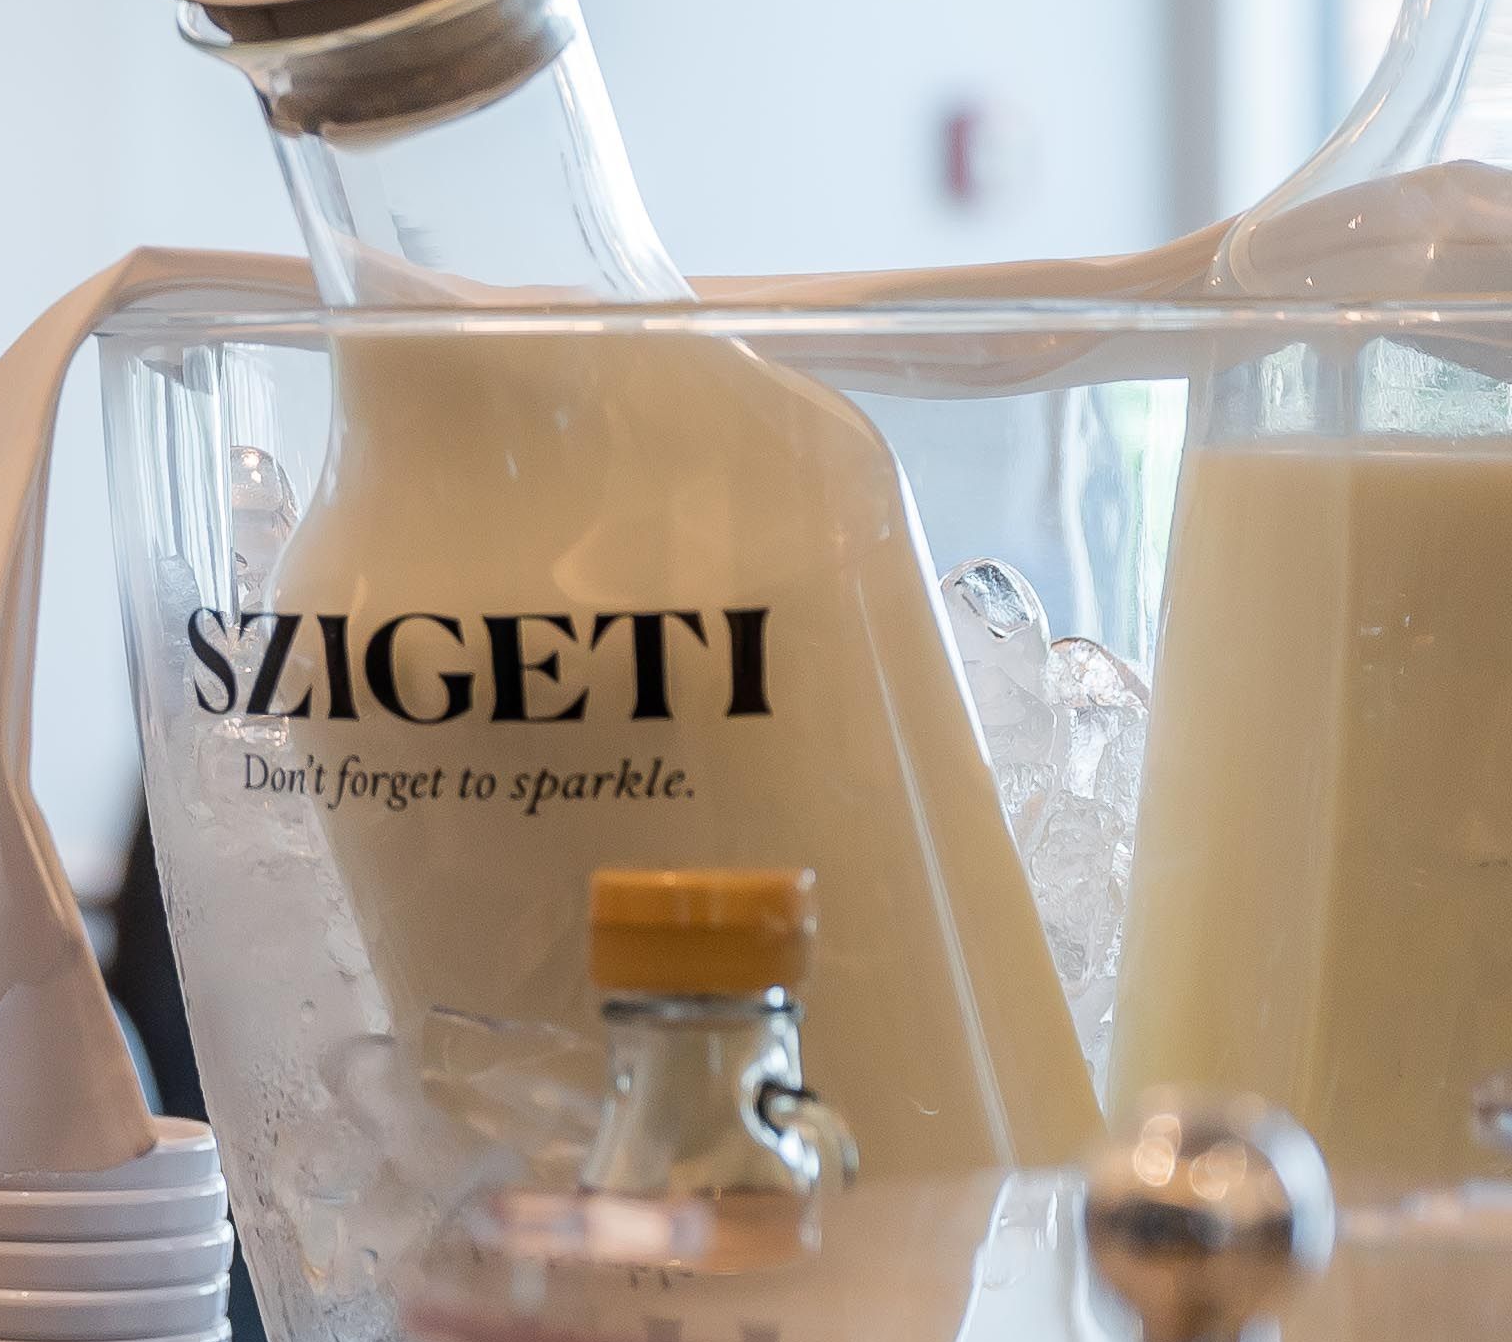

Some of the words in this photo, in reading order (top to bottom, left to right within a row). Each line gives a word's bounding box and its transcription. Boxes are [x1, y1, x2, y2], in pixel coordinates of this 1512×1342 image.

[187, 606, 773, 726] SZIGETI
[244, 753, 326, 796] Don't
[327, 754, 445, 811] forget
[459, 767, 497, 800] to
[510, 757, 696, 817] sparkle.
